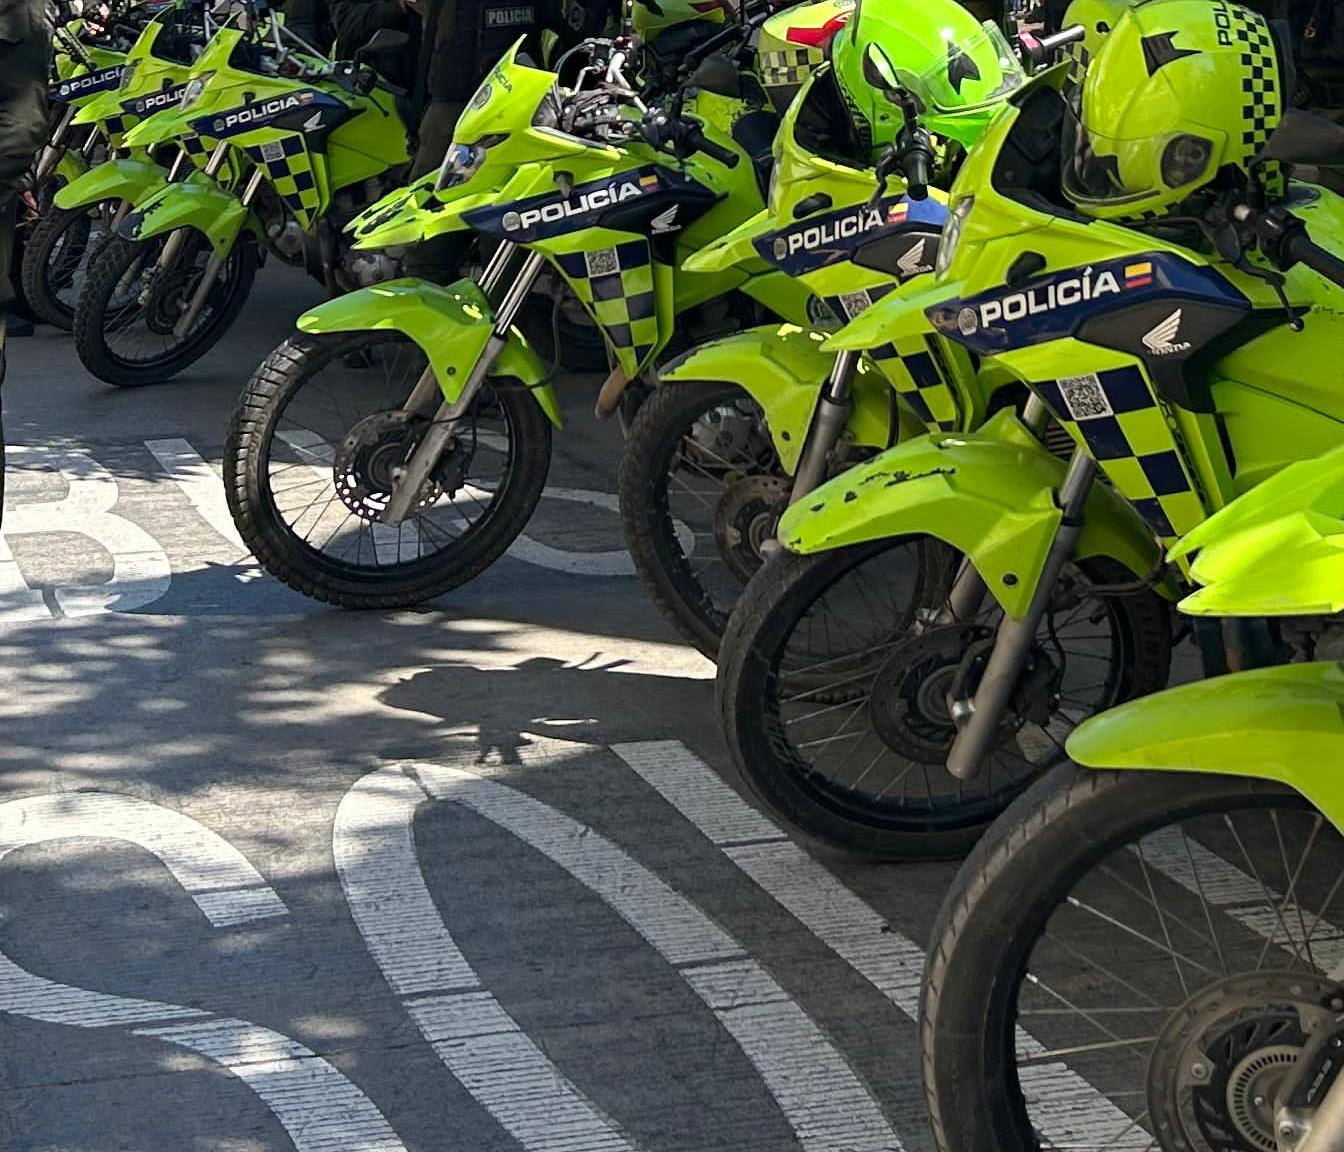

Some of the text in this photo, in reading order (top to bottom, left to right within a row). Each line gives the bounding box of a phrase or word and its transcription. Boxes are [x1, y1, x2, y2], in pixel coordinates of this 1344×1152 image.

[145, 88, 186, 109] POLIC
[520, 181, 643, 230] POLICÍA
[979, 265, 1121, 329] POLICÍA
